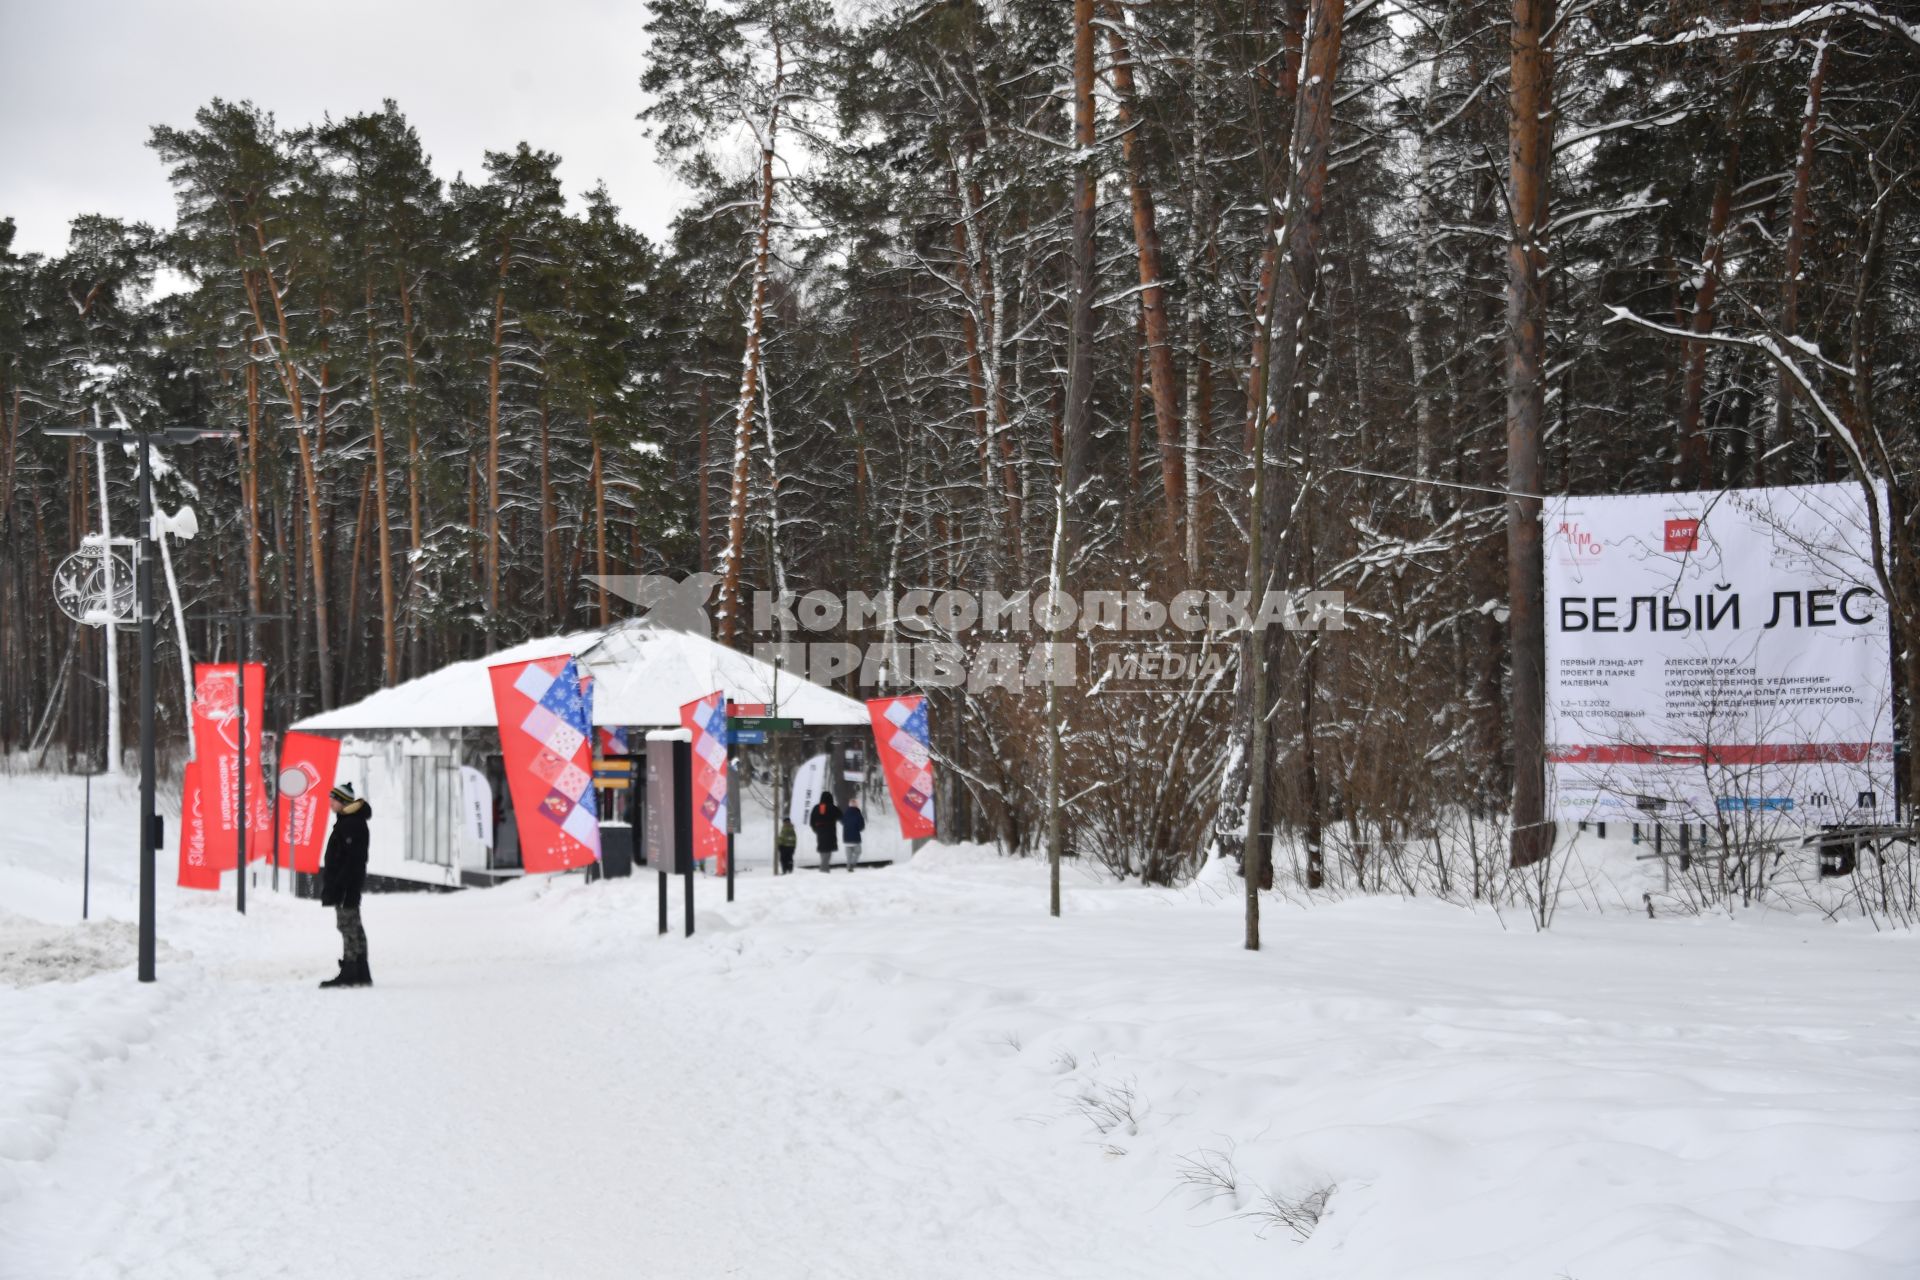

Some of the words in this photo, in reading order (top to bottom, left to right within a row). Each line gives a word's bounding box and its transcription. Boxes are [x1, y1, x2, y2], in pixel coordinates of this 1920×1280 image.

[1669, 528, 1694, 538] JART
[1560, 583, 1740, 633] БЕЛЫЙ
[1764, 587, 1876, 630] ЛЕС
[1560, 658, 1596, 666] ПЕРВЫЙ
[1598, 659, 1644, 667] ЛЭНД-АРТ
[1664, 657, 1708, 666] АЛЕКСЕЙ
[1560, 669, 1594, 677] ПРОЕКТ
[1596, 669, 1603, 677] В
[1605, 669, 1635, 677] ПАРКЕ
[1664, 668, 1714, 676] ГРИГОРИЙ
[1716, 668, 1756, 676] ОРЕХОВ
[1665, 689, 1700, 698] (ИРИНА
[1704, 689, 1743, 697] КОРИНА
[1755, 688, 1787, 696] ОЛЬГА
[1789, 686, 1855, 695] ПЕТРУНЕНКО,
[1779, 696, 1863, 706] АРХИТЕКТОРОВ»,
[1560, 710, 1583, 718] ВХОД
